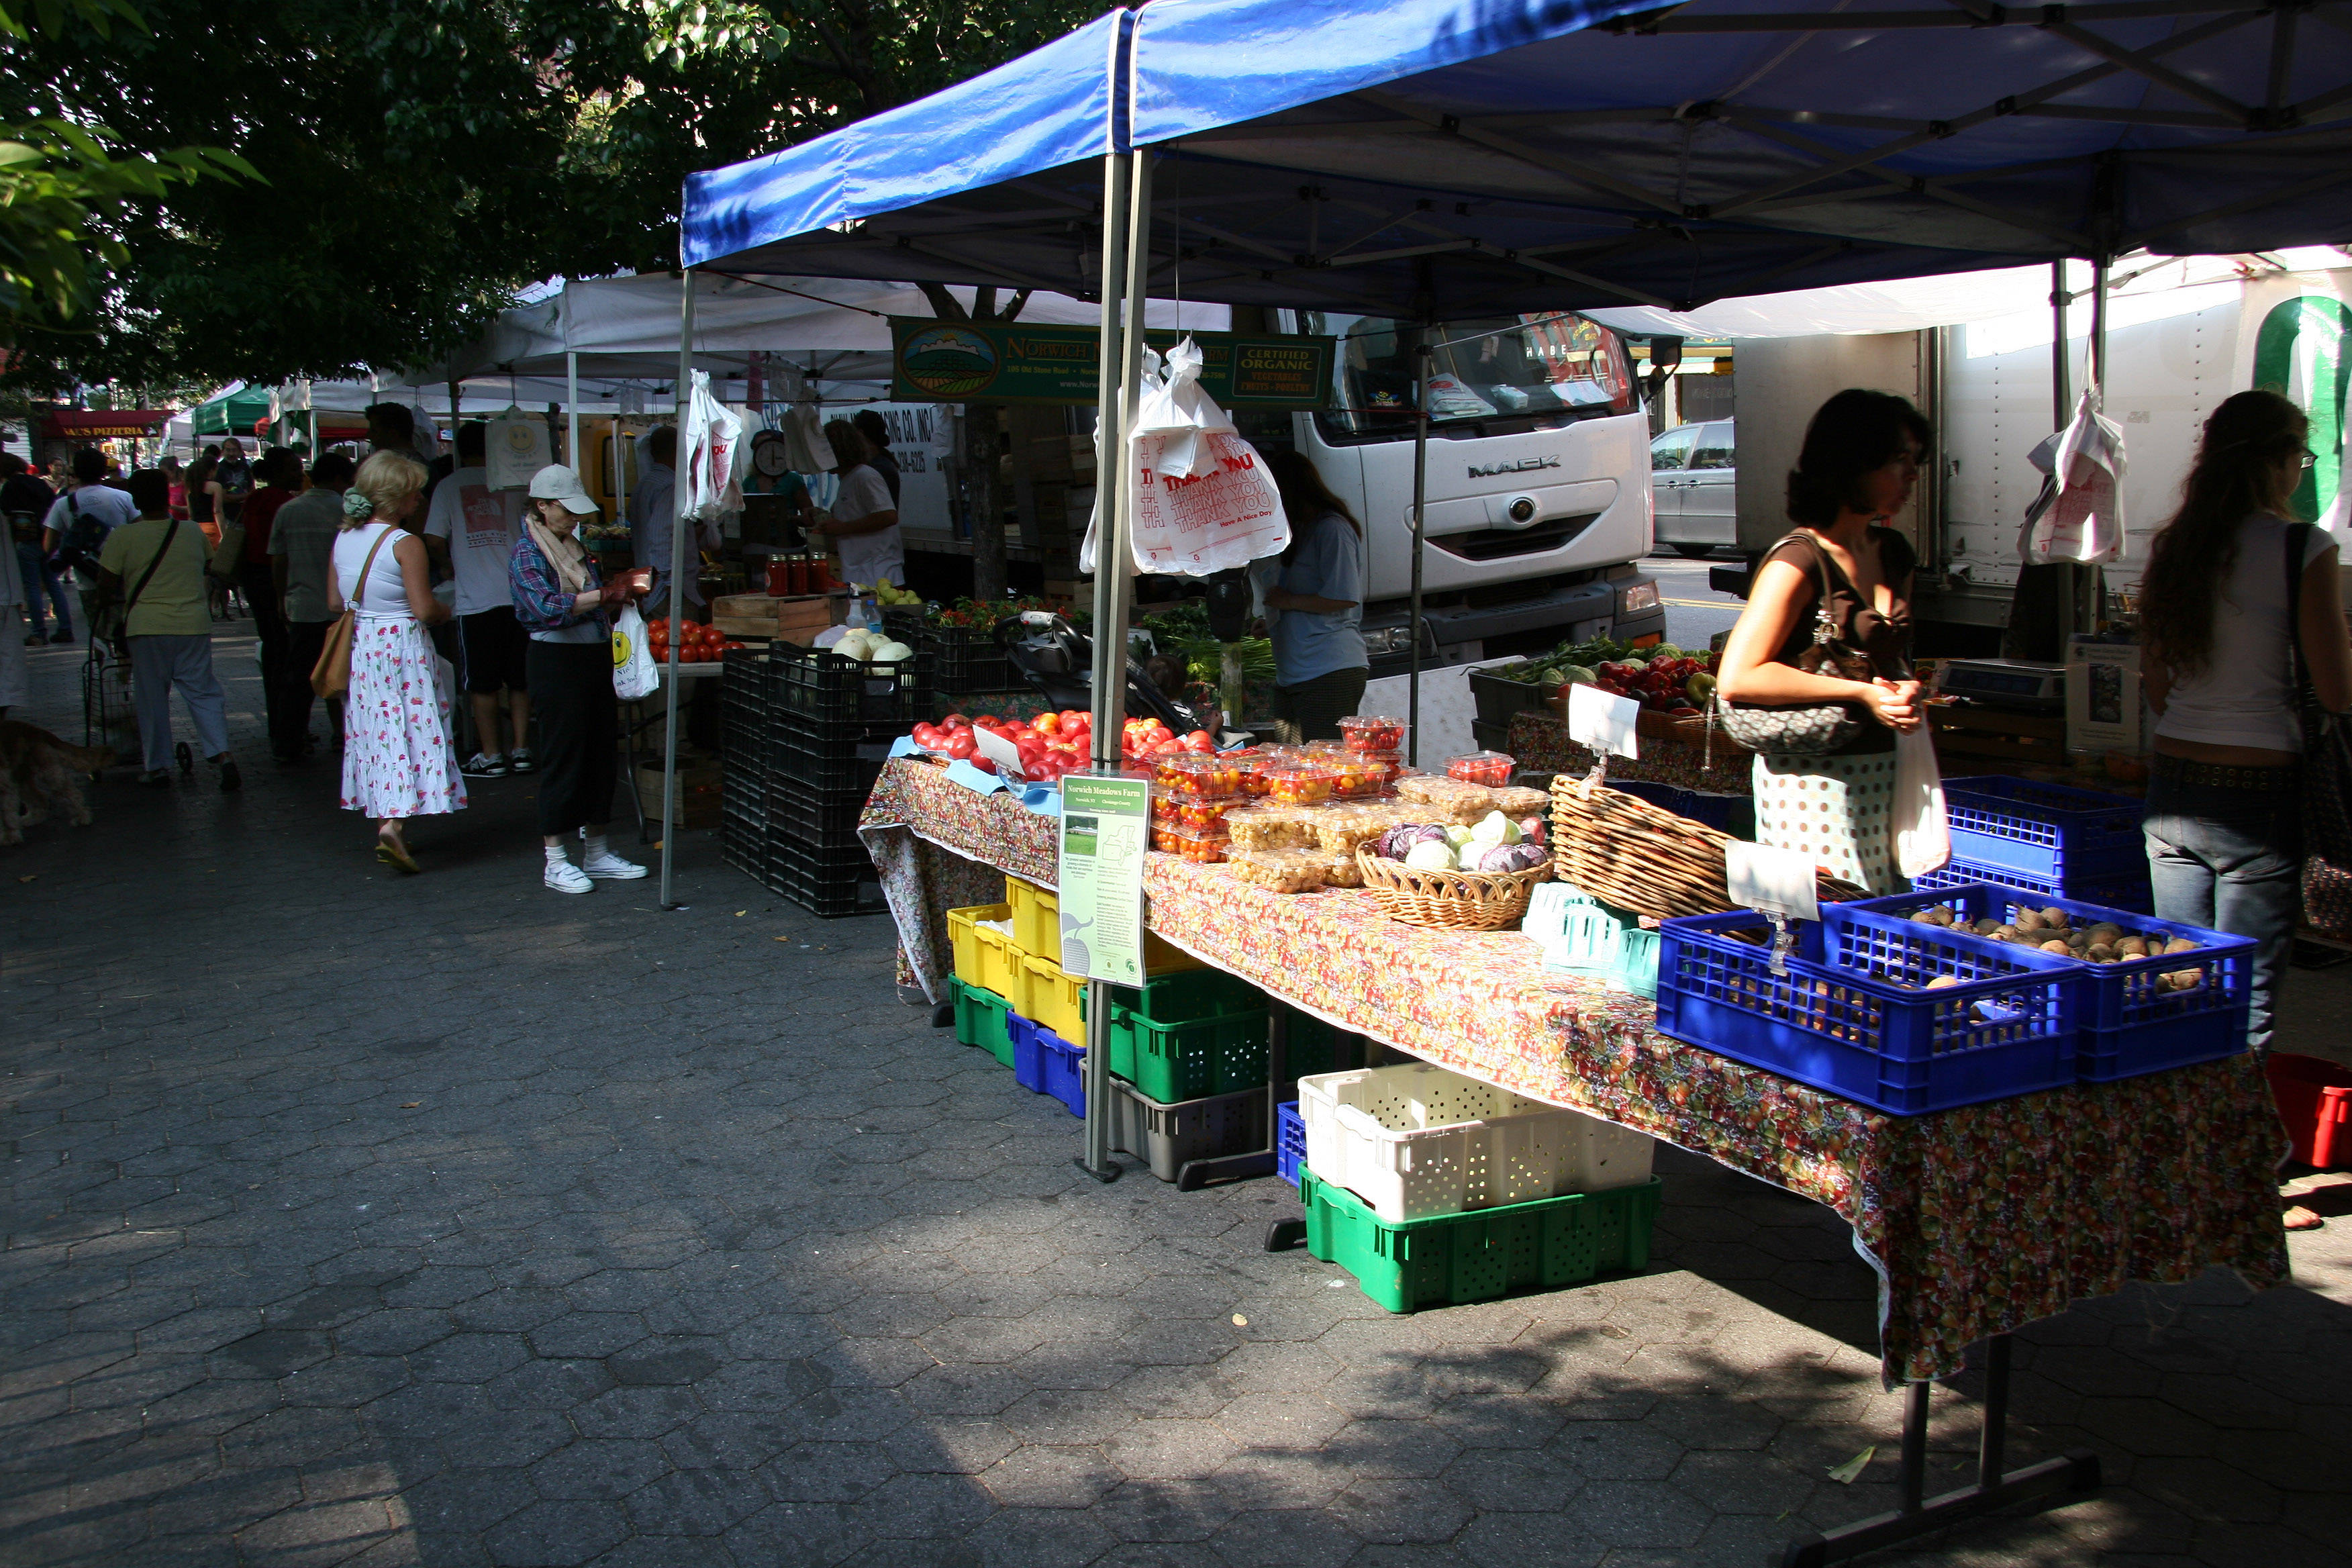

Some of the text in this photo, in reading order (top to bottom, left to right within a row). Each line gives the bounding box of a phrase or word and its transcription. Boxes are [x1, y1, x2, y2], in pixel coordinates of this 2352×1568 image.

[1006, 337, 1089, 359] NORWICH
[1247, 349, 1309, 359] CERTIFIED
[1240, 359, 1314, 370] ORGANIC
[1251, 372, 1302, 381] VEGETABLES
[1241, 381, 1310, 392] FRUITS POULTRY
[93, 426, 145, 436] PIZZERIA
[1468, 454, 1561, 478] MACK
[1167, 465, 1259, 505] THANK YOU
[1171, 479, 1265, 520] THANK YOU
[1175, 493, 1270, 533] THANK YOU
[1220, 520, 1236, 528] Have
[1067, 785, 1140, 797] Norwich Meadows Farm
